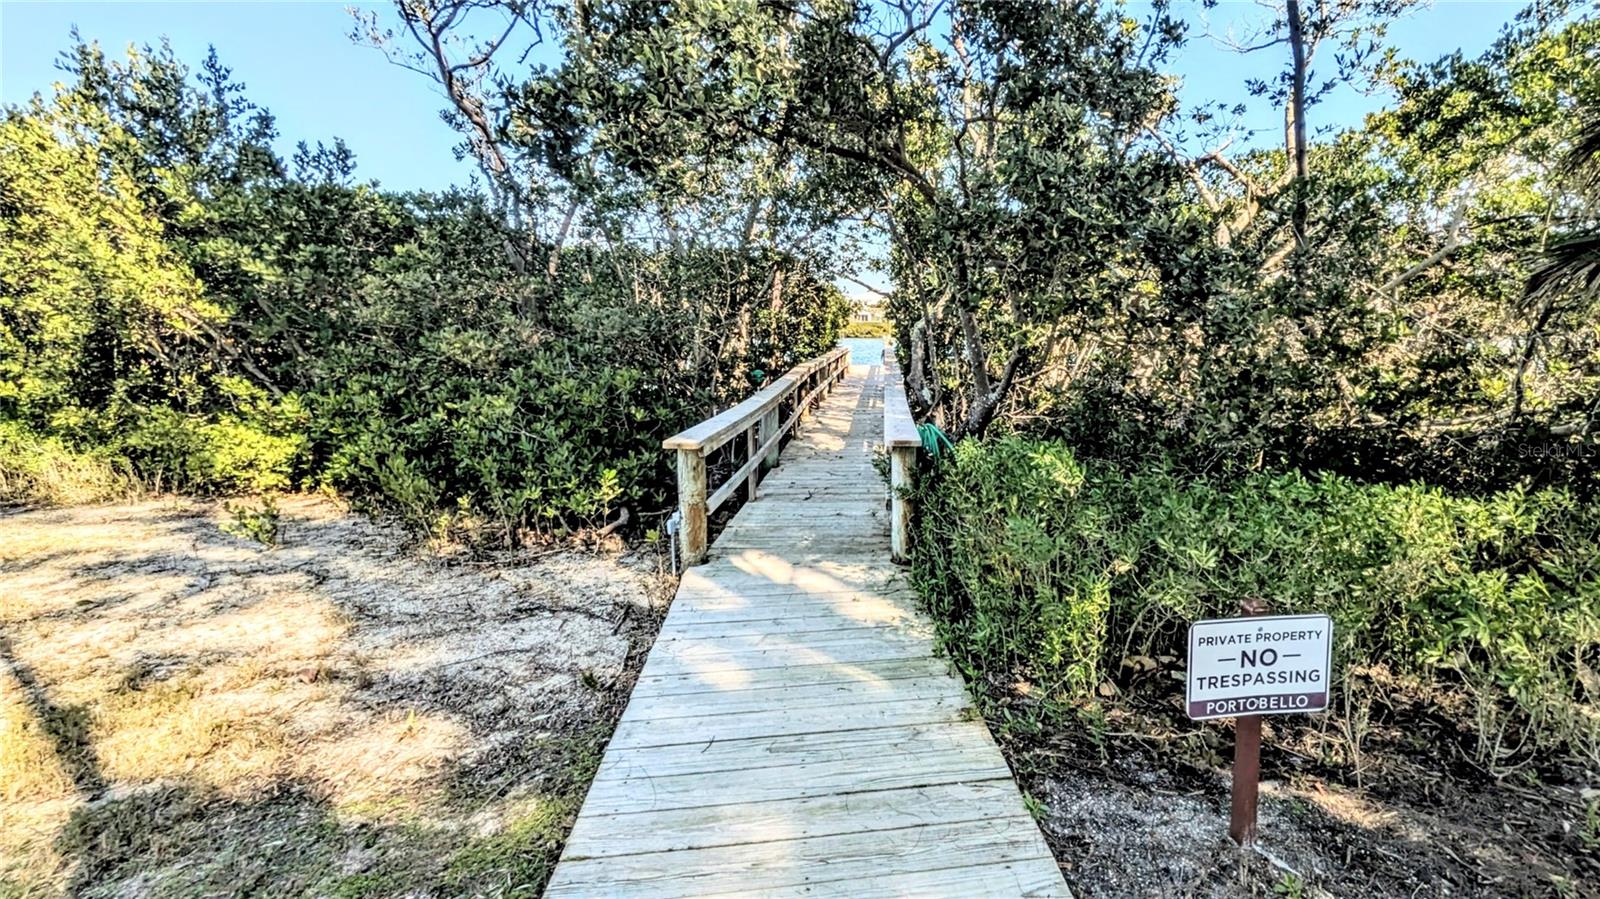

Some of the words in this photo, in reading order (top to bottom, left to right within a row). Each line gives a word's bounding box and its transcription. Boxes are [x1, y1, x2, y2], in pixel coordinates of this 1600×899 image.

[1198, 634, 1252, 647] PRIVATE
[1256, 630, 1323, 643] PROPERTY
[1240, 648, 1278, 668] NO
[1197, 669, 1320, 690] TRESPASSING
[1206, 695, 1308, 714] PORTOBELLO
